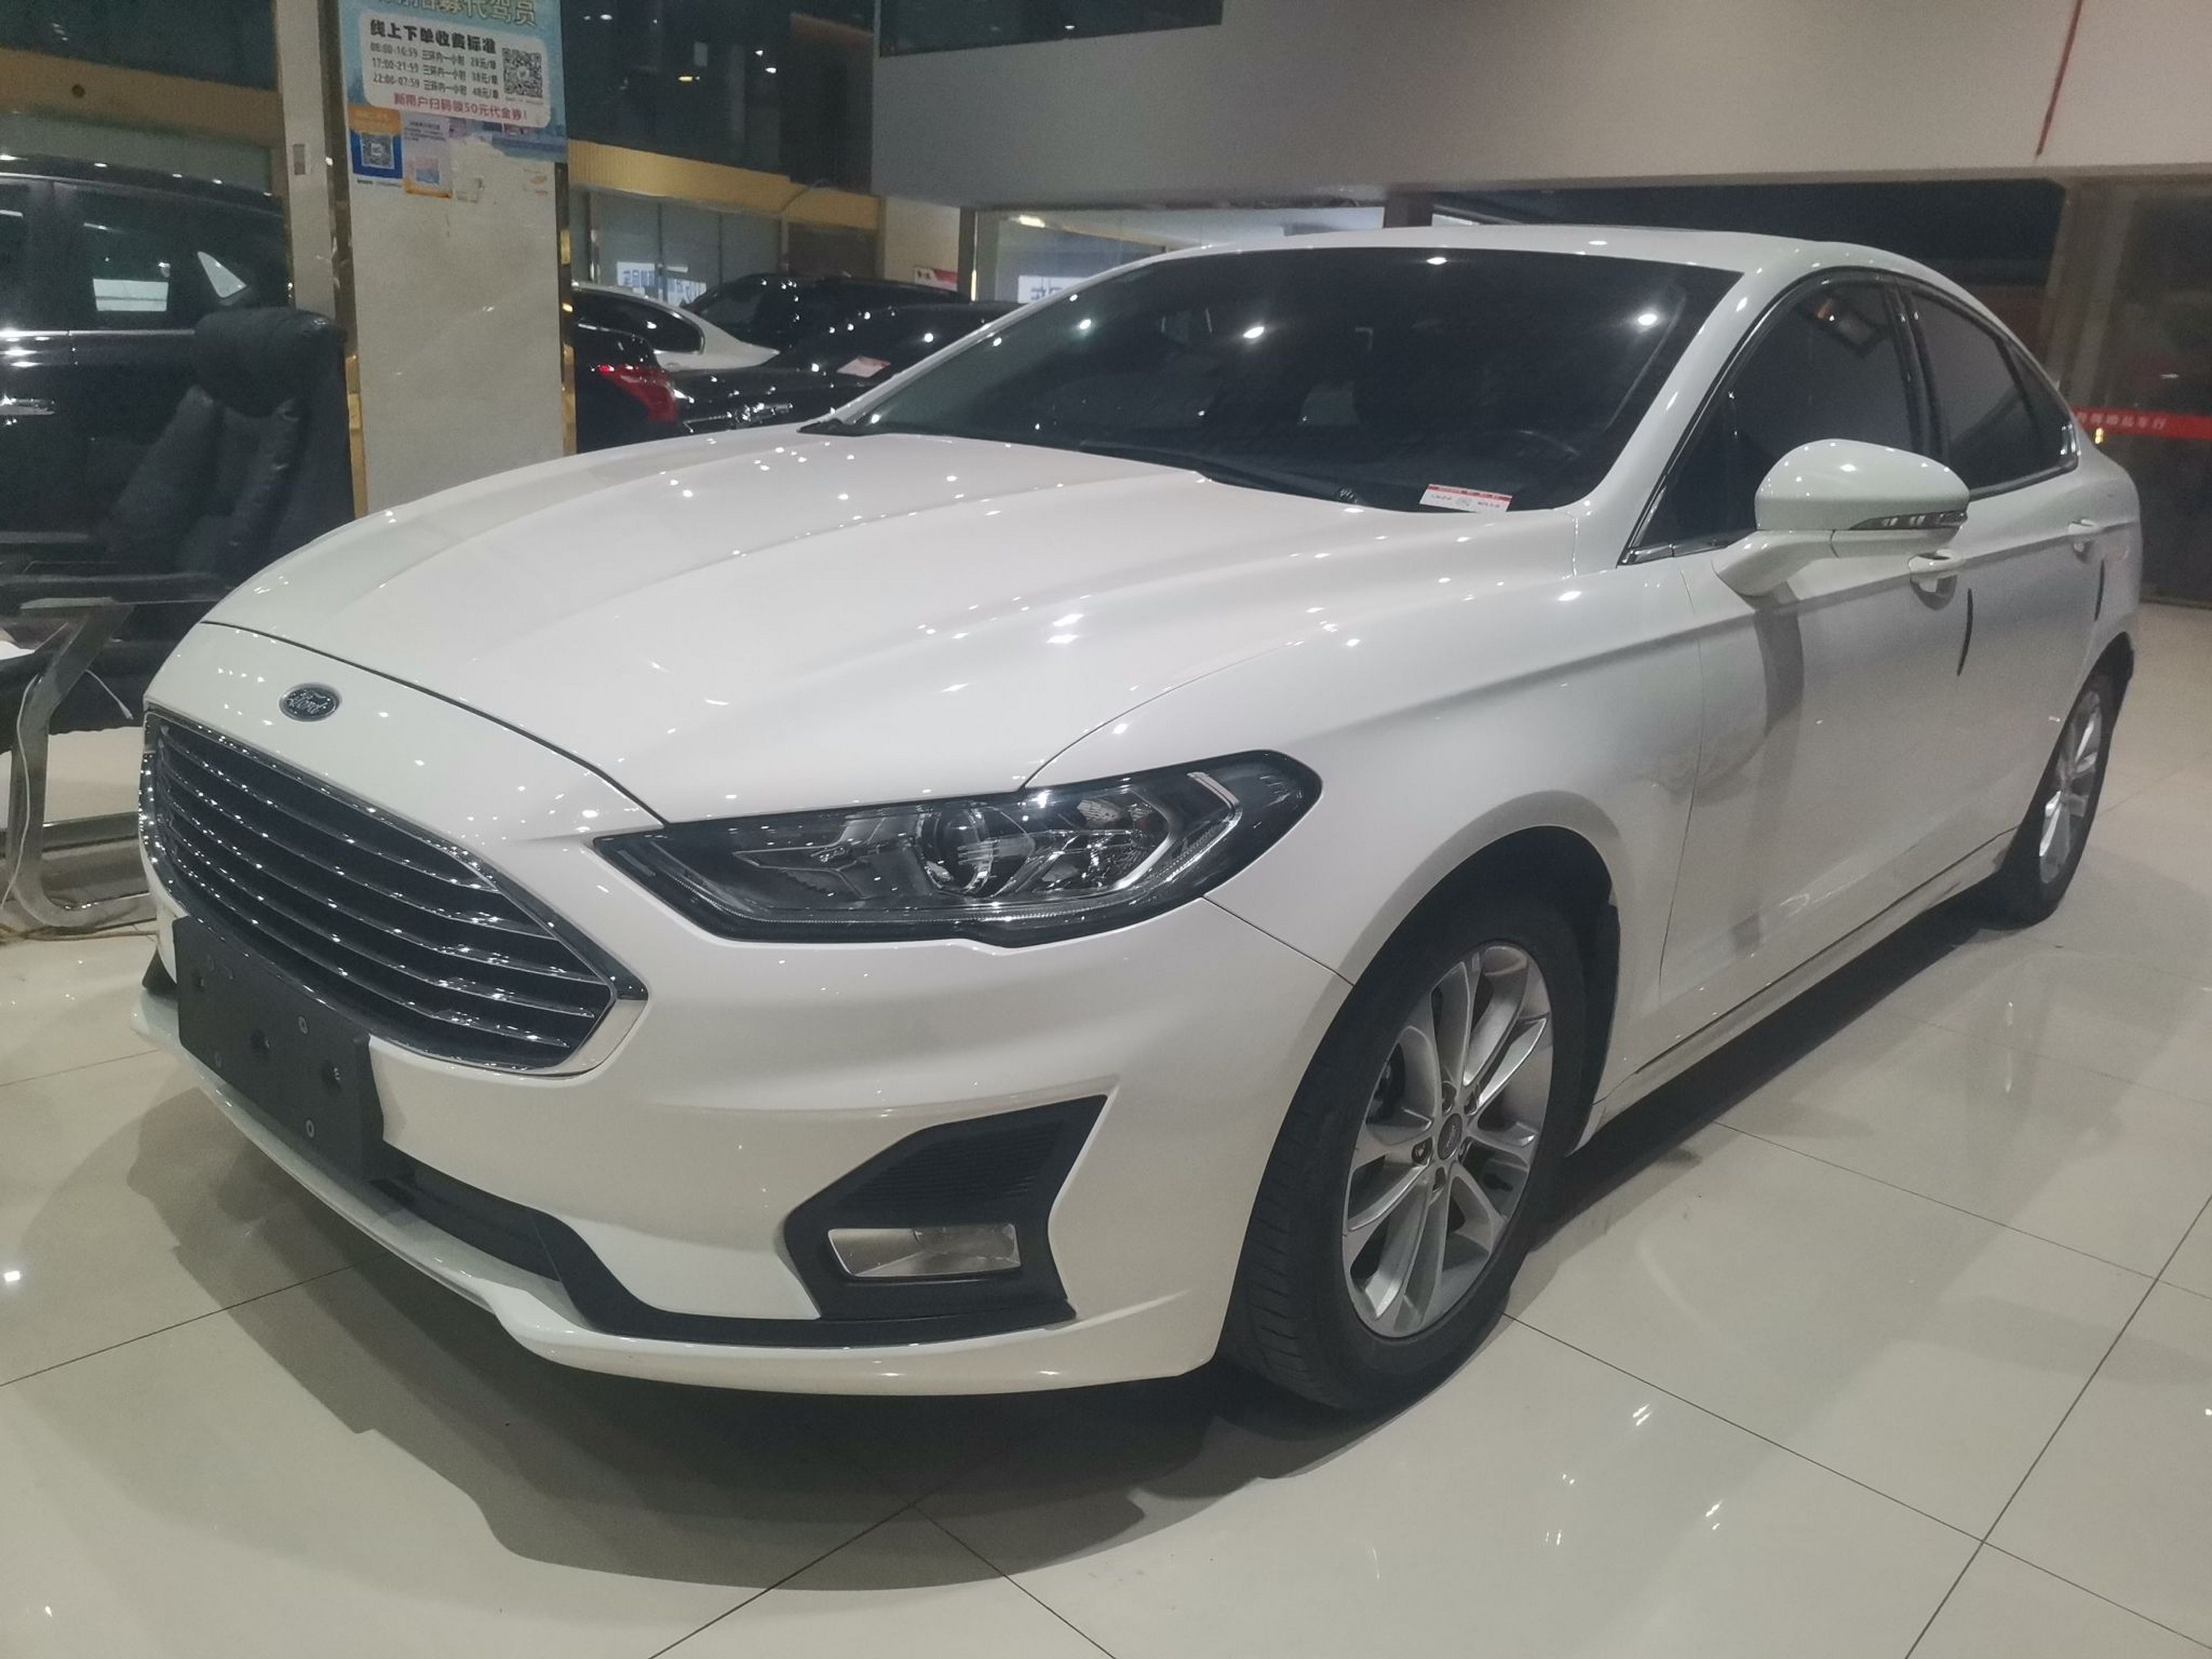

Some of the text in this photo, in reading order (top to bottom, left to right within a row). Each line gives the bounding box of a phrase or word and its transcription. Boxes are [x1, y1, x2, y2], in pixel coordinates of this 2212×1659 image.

[370, 19, 497, 54] 线上下单收费标准
